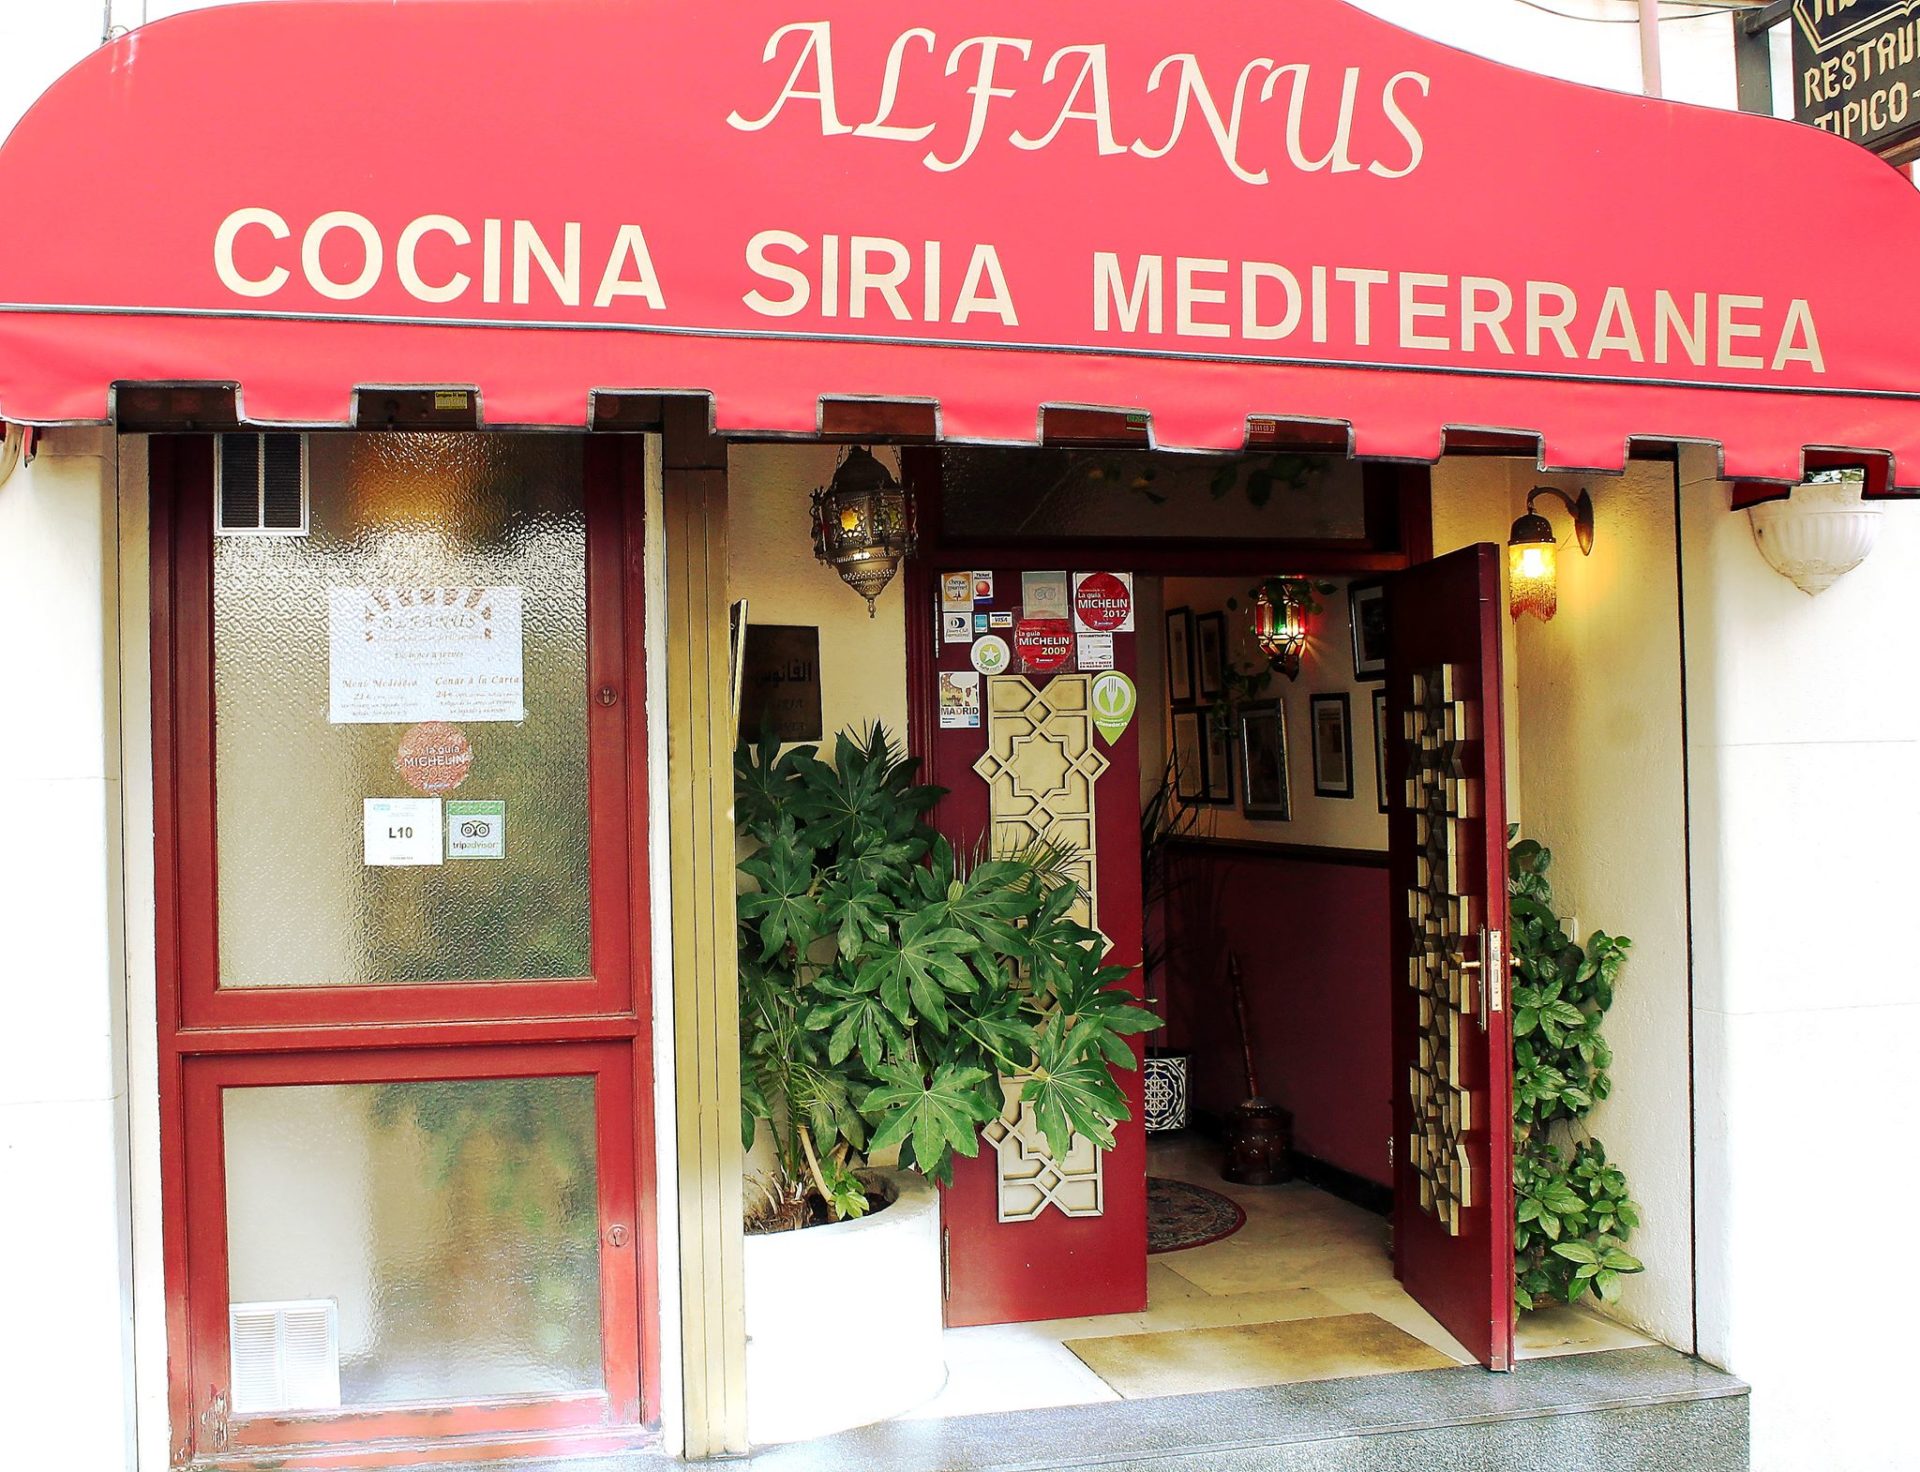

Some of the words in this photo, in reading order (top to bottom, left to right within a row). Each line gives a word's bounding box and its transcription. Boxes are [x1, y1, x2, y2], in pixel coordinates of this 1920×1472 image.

[1803, 18, 1920, 109] RESTAU
[726, 20, 1431, 185] ALFANUS
[213, 207, 667, 311] COCINA
[742, 230, 1019, 327] SIRIA
[1093, 252, 1826, 374] MEDITERRANEA
[1078, 598, 1128, 609] MICHELIN
[1102, 609, 1127, 618] 2012
[1019, 637, 1070, 646] MICHELIN
[1041, 647, 1067, 655] 2009
[941, 706, 979, 716] MADRID
[404, 754, 466, 767] MICHELIN
[388, 826, 414, 839] L10
[452, 840, 498, 851] tripadvisor
